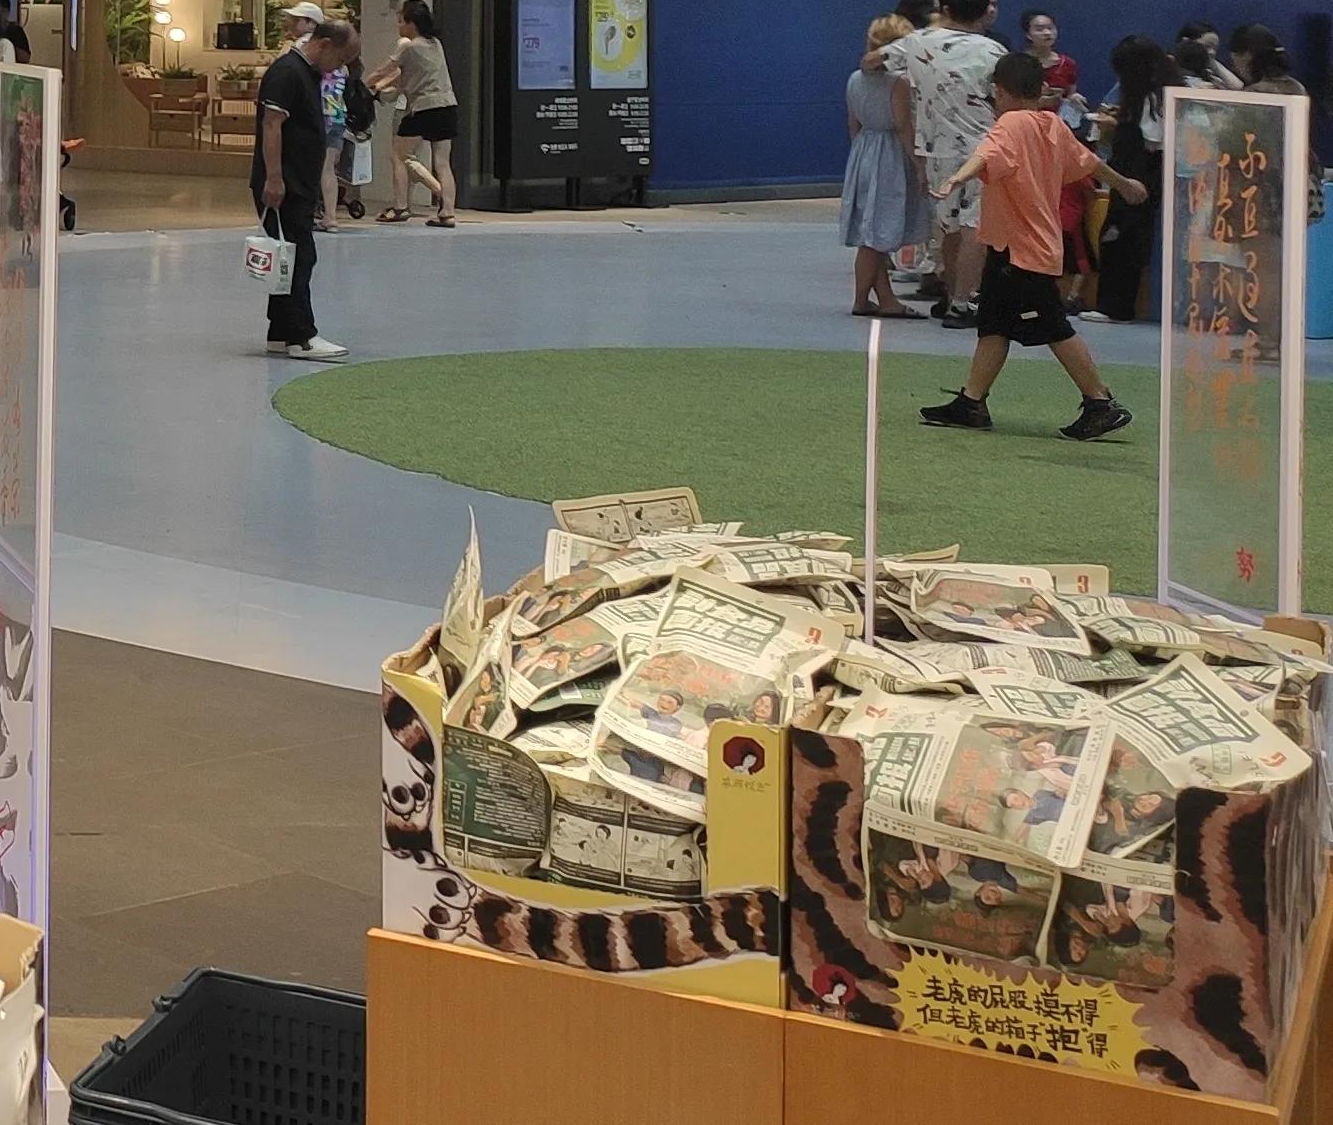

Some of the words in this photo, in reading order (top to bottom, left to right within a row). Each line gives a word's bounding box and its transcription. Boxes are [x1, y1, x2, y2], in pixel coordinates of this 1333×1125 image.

[921, 974, 1101, 1028] 老虎的屁股摸不得
